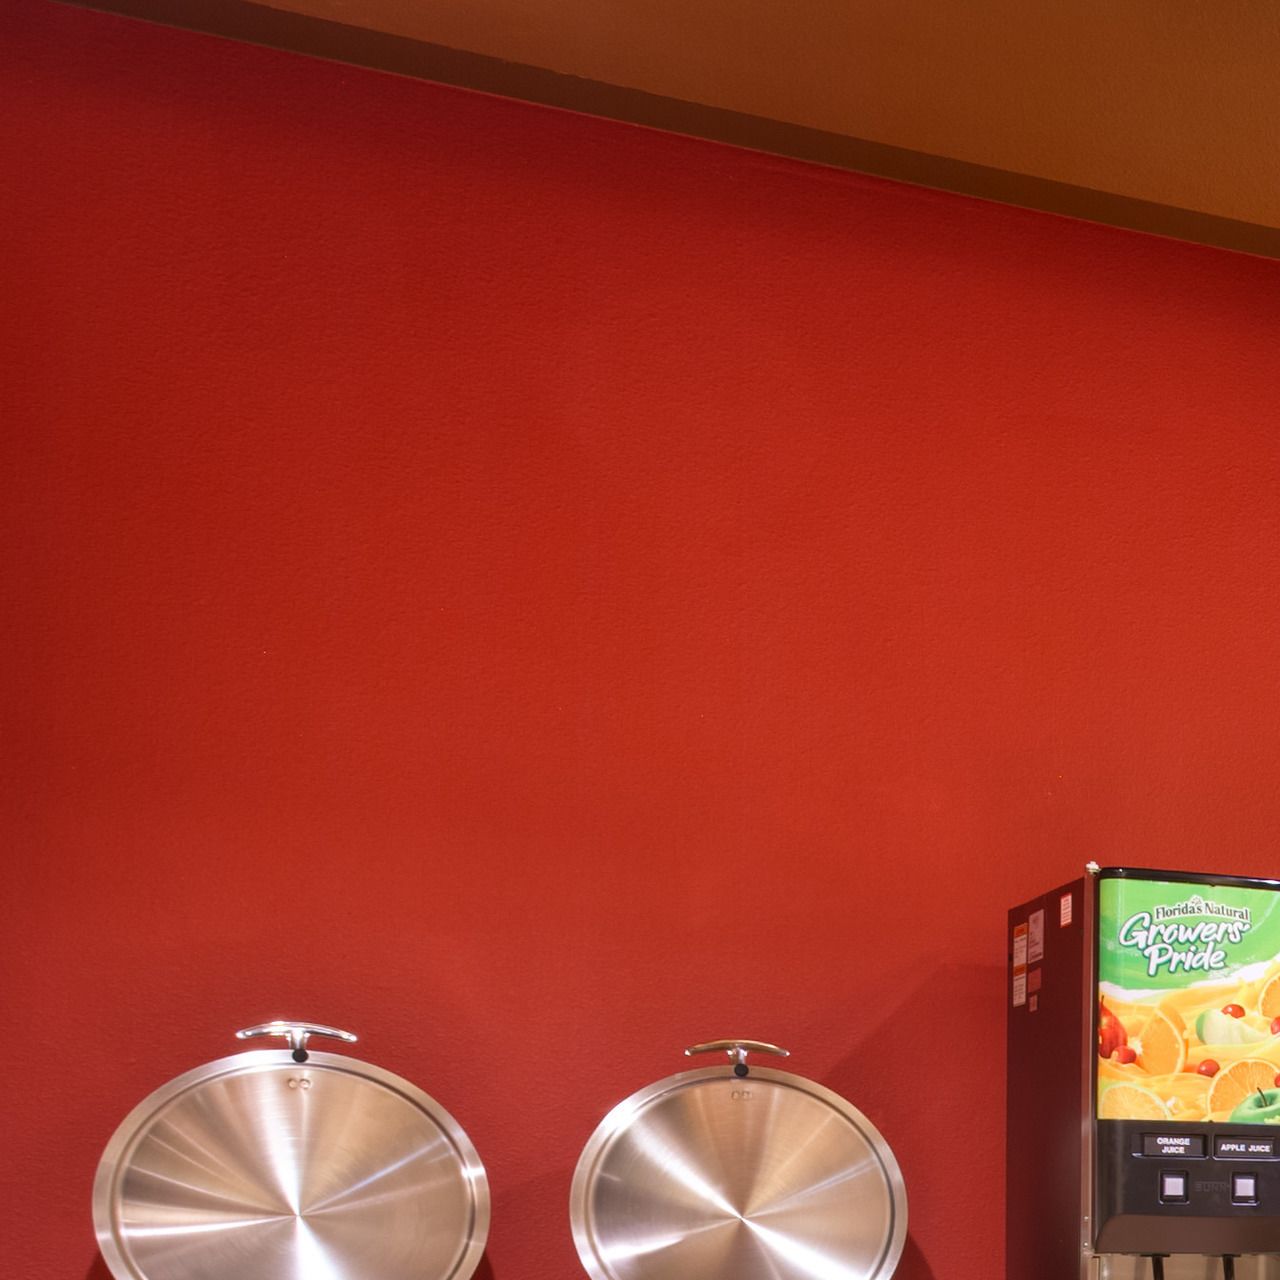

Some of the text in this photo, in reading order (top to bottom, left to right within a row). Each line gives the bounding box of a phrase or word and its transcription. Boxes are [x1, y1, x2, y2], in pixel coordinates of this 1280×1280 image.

[1156, 902, 1248, 920] Florida's Natural
[1143, 941, 1227, 978] Pride
[1156, 1137, 1191, 1146] ORANGE
[1162, 1146, 1185, 1154] JUICE
[1221, 1144, 1271, 1153] APPLE JUICE
